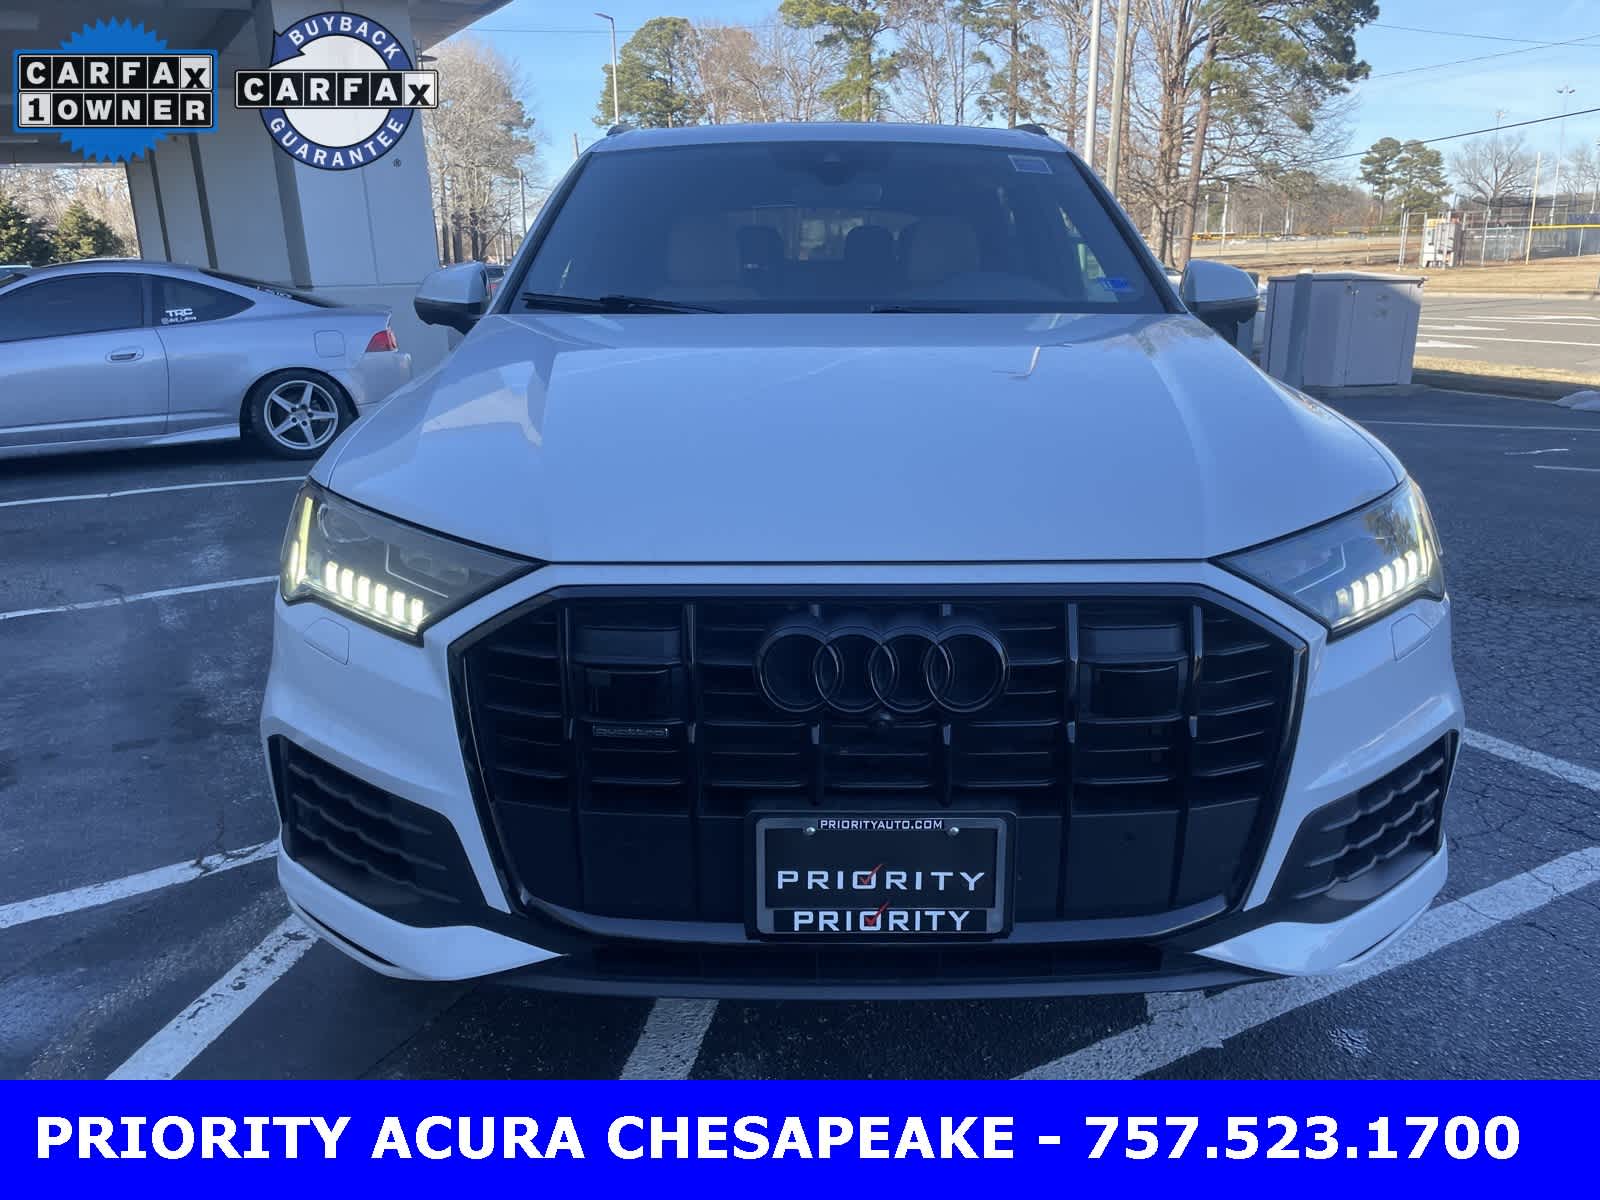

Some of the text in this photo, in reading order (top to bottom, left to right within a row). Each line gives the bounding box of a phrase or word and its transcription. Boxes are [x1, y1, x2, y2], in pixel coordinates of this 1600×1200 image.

[820, 819, 943, 830] PRIORITYAUTO.COM
[777, 869, 985, 891] PRIORITY
[793, 909, 970, 932] PRIORITY
